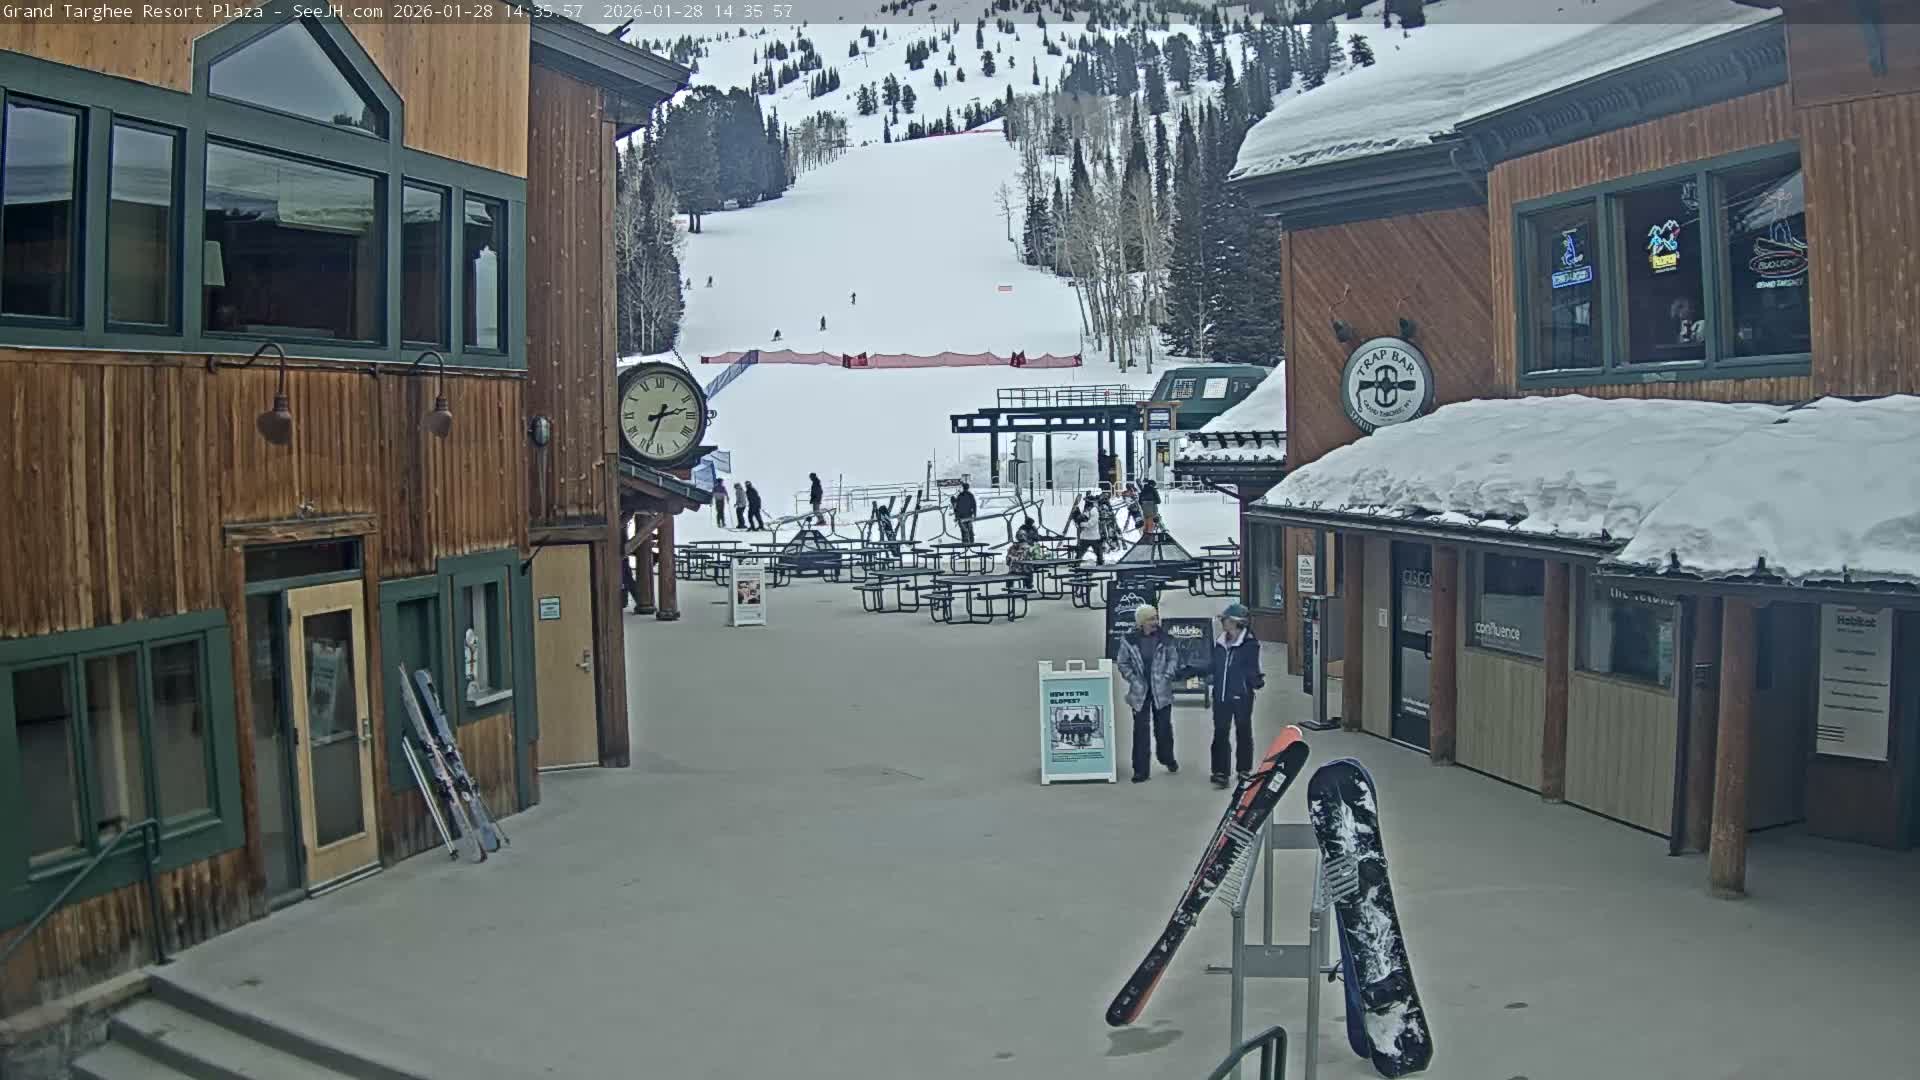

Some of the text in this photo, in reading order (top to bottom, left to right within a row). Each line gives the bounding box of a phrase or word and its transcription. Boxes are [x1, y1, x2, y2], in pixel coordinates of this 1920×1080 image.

[1357, 349, 1415, 376] TRAP BAR
[1168, 624, 1203, 638] Modelo
[1475, 621, 1520, 640] confluence
